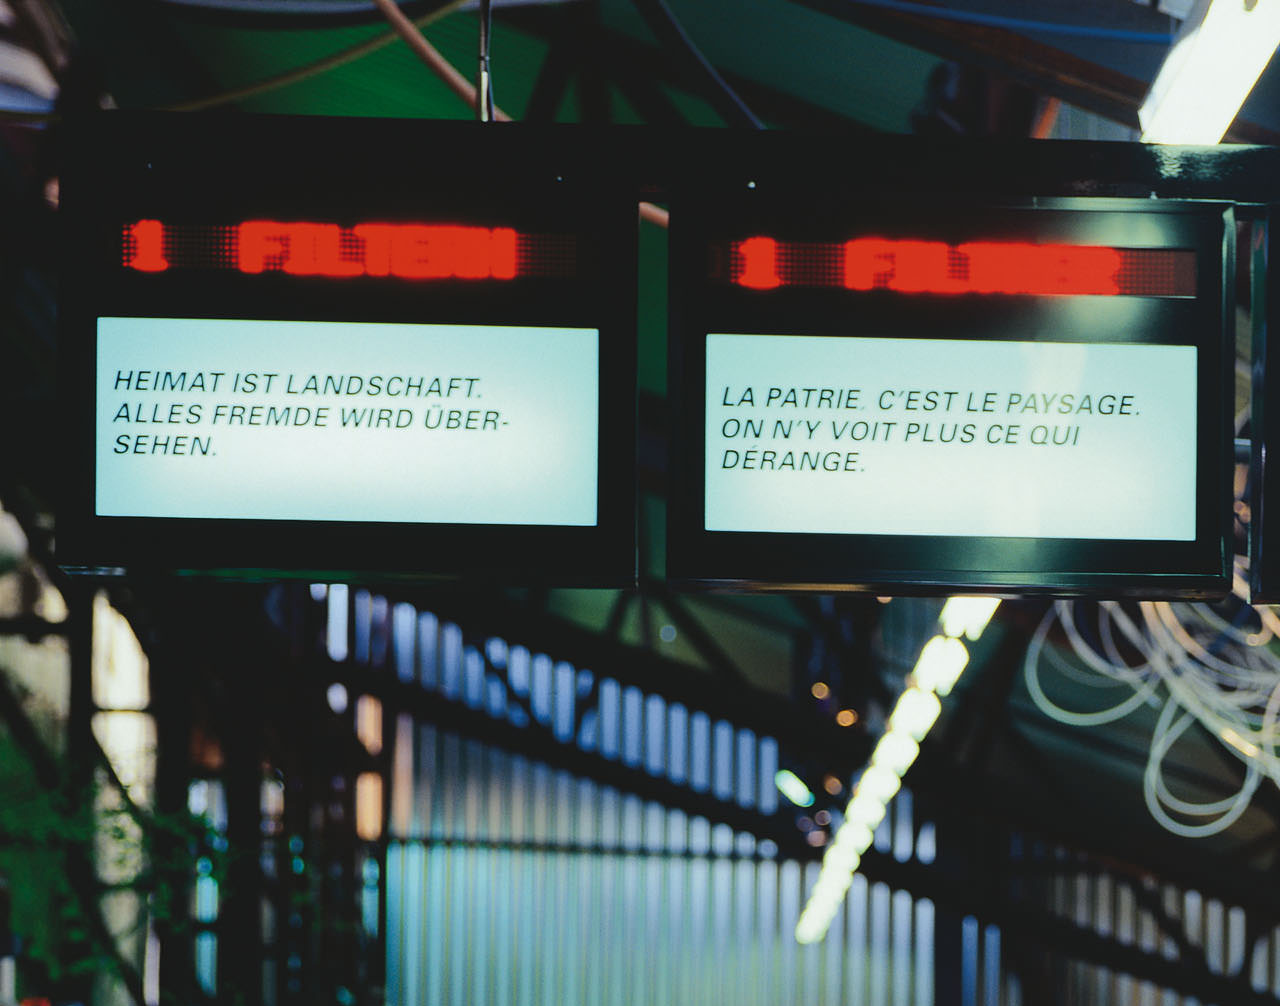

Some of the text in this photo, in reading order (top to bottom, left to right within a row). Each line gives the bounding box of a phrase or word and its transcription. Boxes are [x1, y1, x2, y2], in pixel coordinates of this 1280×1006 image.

[113, 369, 482, 399] HEIMAT IST LANDSCHAFT.
[721, 385, 755, 408] LA
[878, 389, 960, 412] C'EST
[965, 391, 998, 413] LE
[1006, 392, 1141, 416] PAYSAGE.
[112, 402, 510, 431] ALLES FREMDE WIRD ÜBER-
[112, 434, 217, 457] SEHEN.
[721, 418, 1080, 446] ON N'Y VOIT PLUS CE QUI
[721, 444, 866, 473] DÉRANGE.
